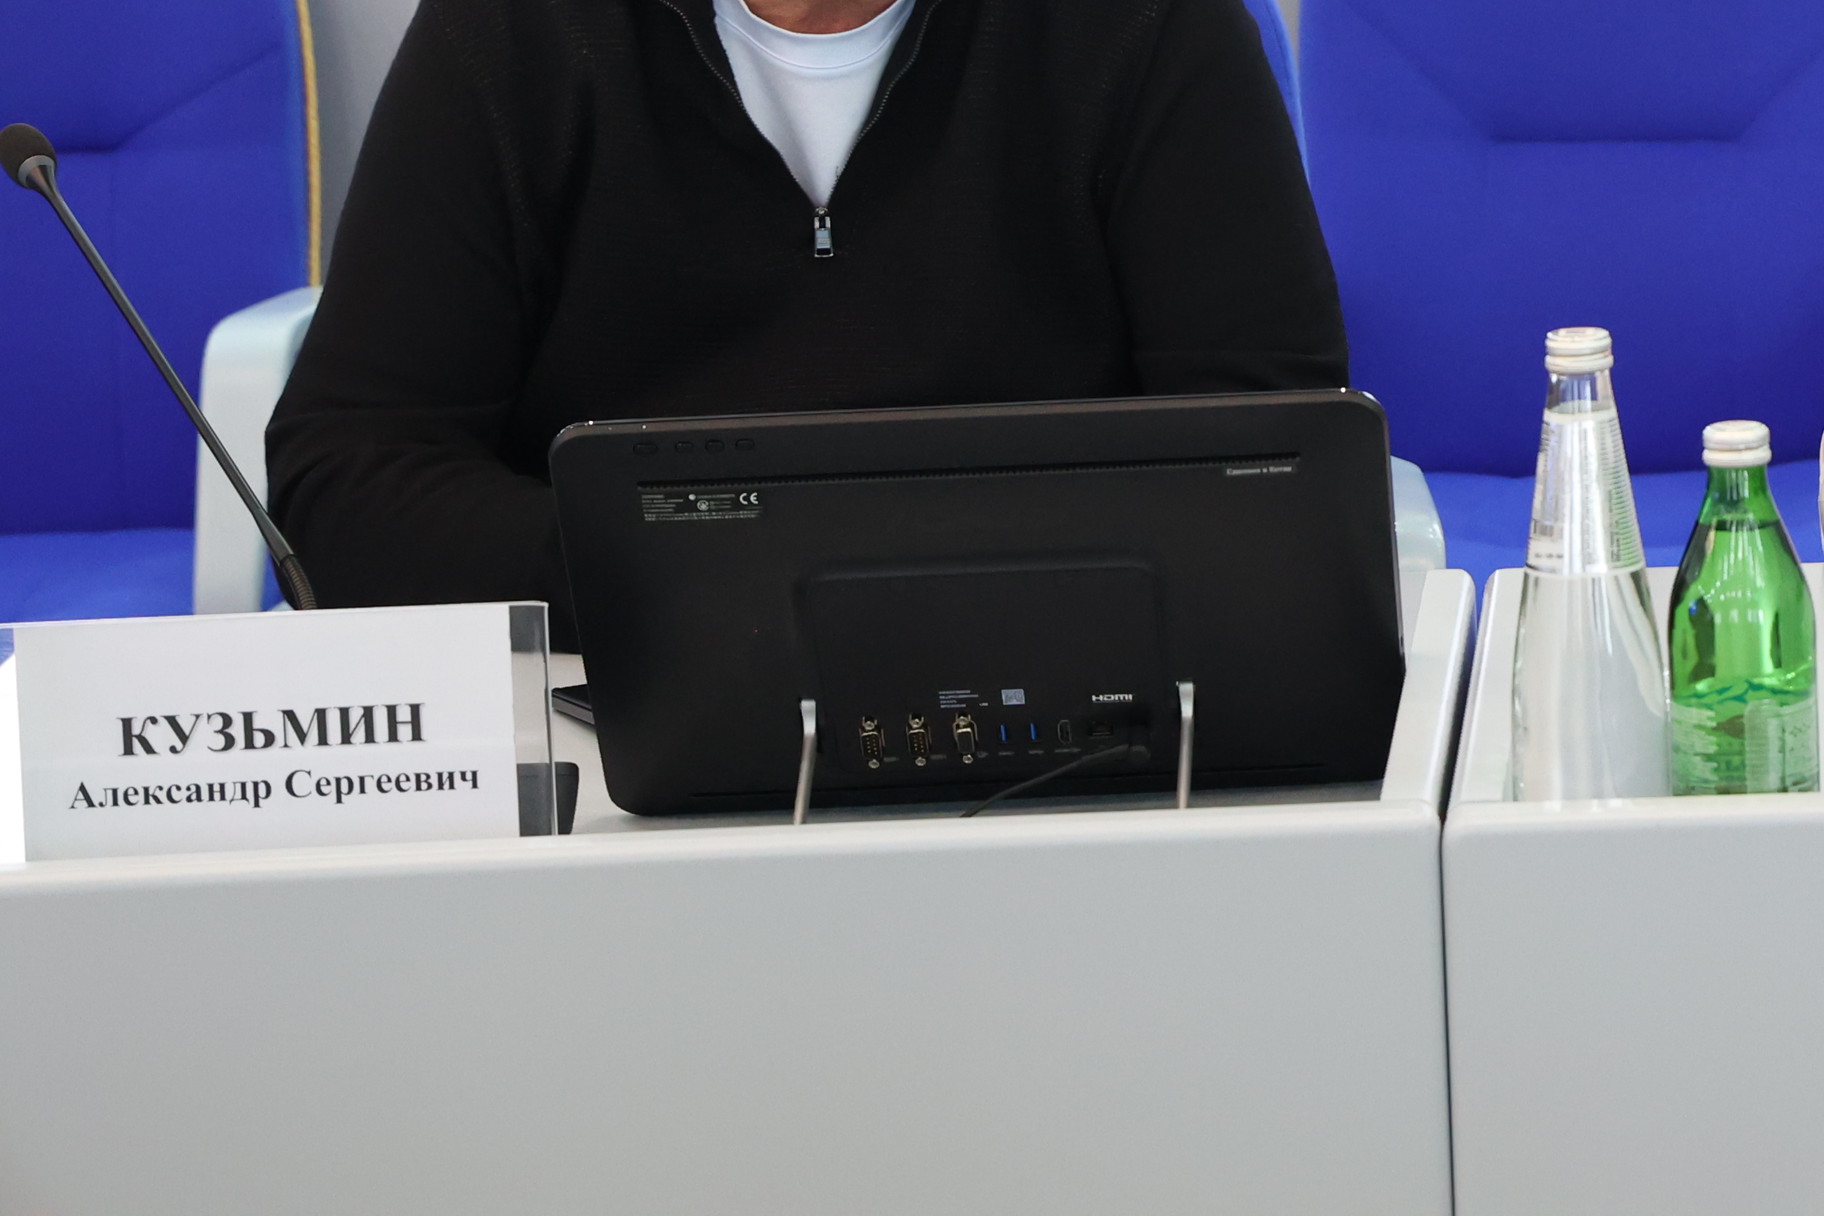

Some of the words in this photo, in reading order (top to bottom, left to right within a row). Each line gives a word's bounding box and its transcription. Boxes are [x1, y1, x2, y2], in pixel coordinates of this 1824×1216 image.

[1091, 693, 1133, 703] HDMI
[116, 701, 427, 757] КУЗЬМИН
[69, 778, 272, 811] Александр
[284, 768, 481, 805] Сергеевич
